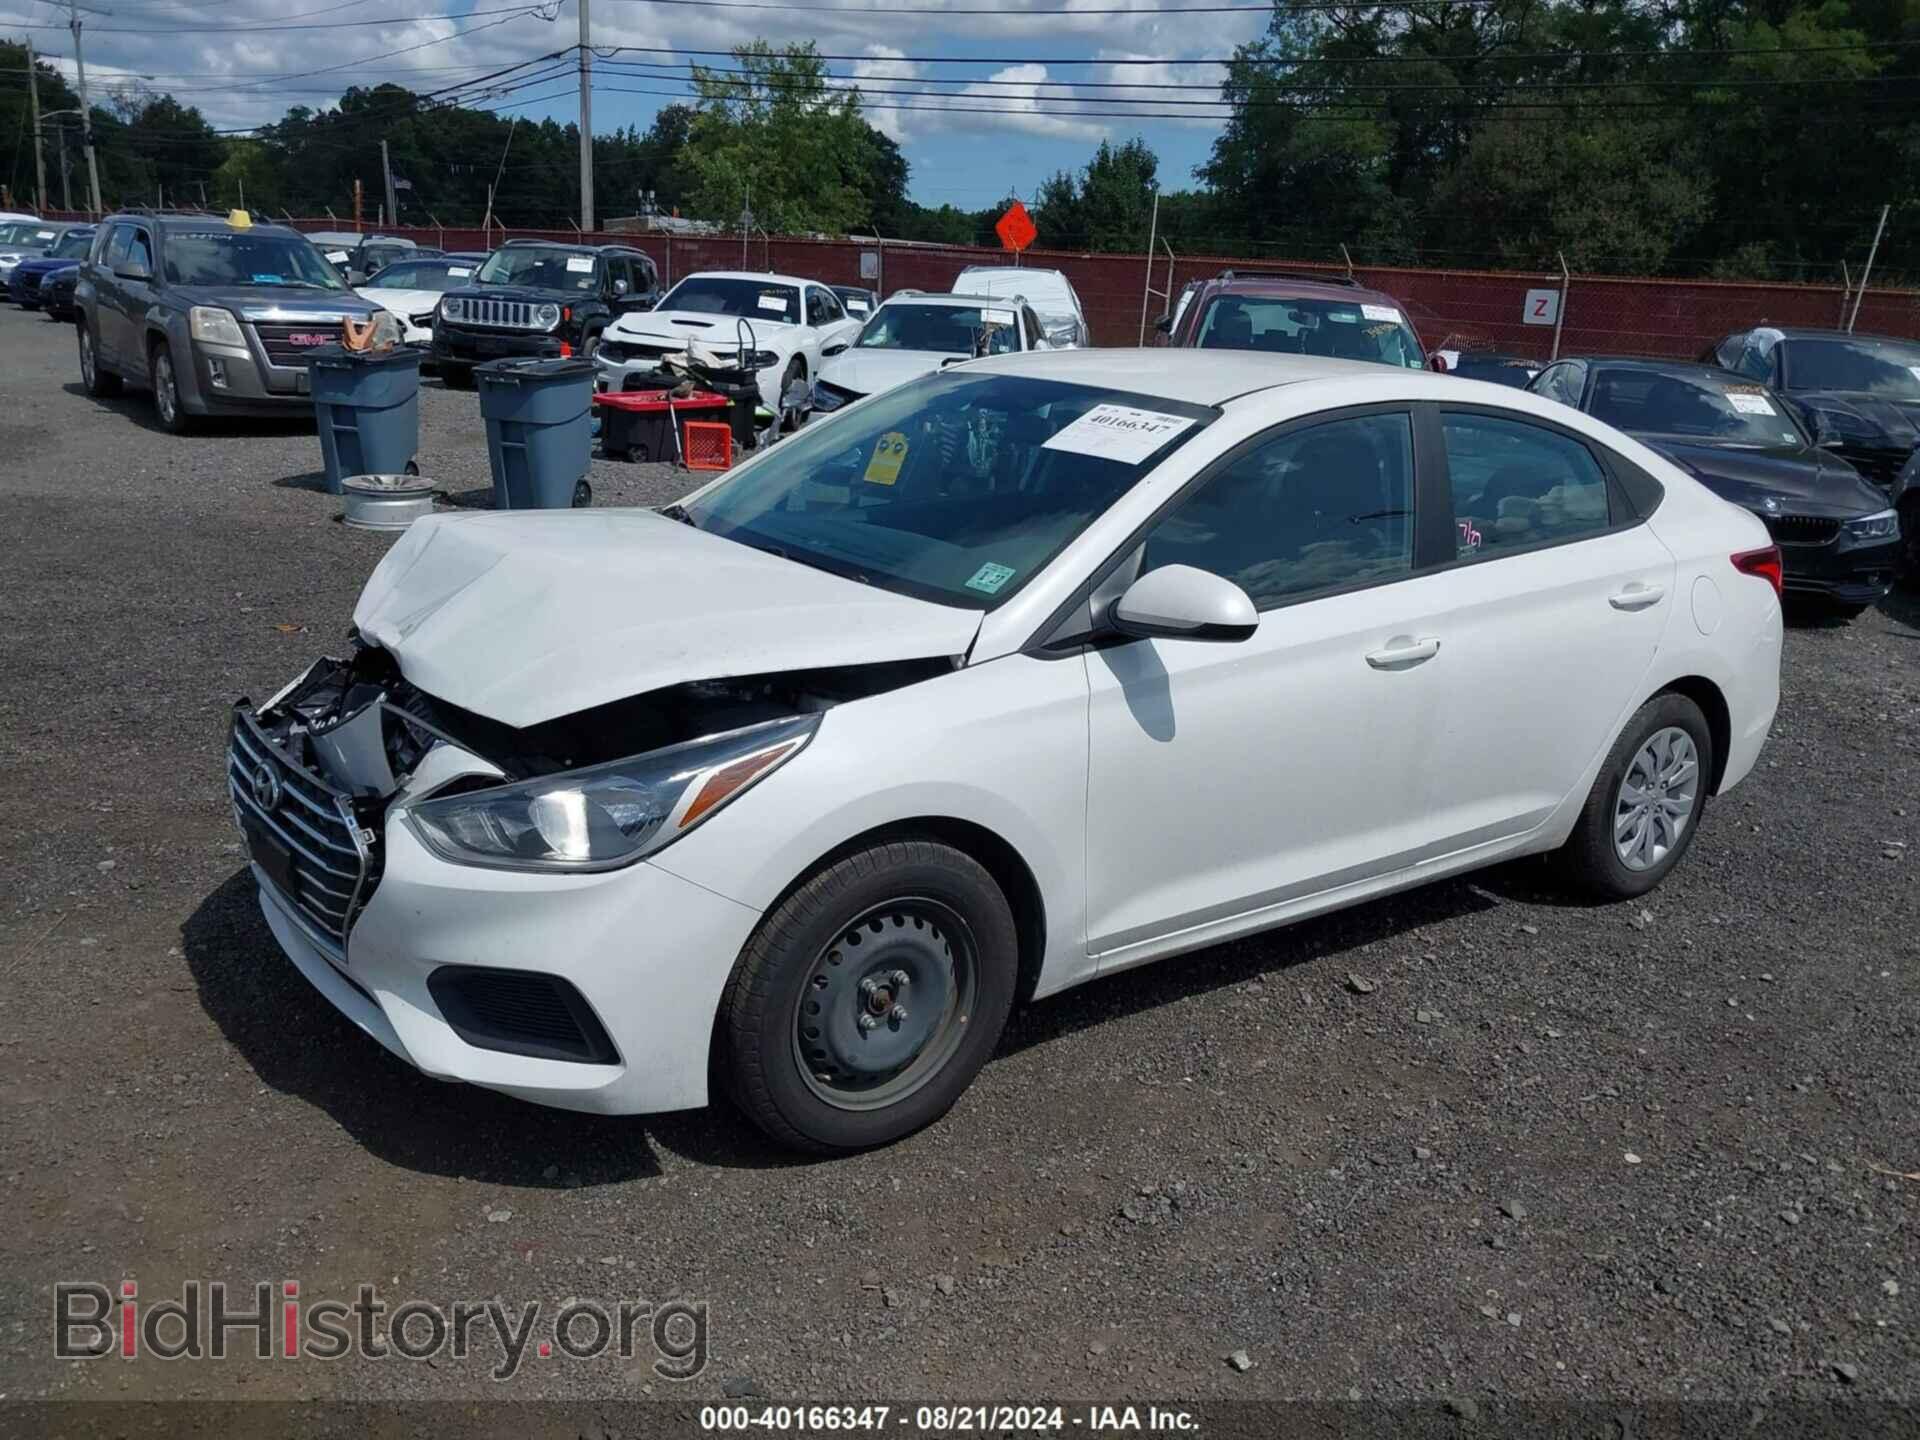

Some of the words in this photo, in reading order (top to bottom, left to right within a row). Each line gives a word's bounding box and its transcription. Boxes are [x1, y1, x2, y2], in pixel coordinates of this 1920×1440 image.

[1534, 299, 1548, 317] Z
[289, 333, 335, 346] GMC
[1090, 414, 1171, 434] 40166347
